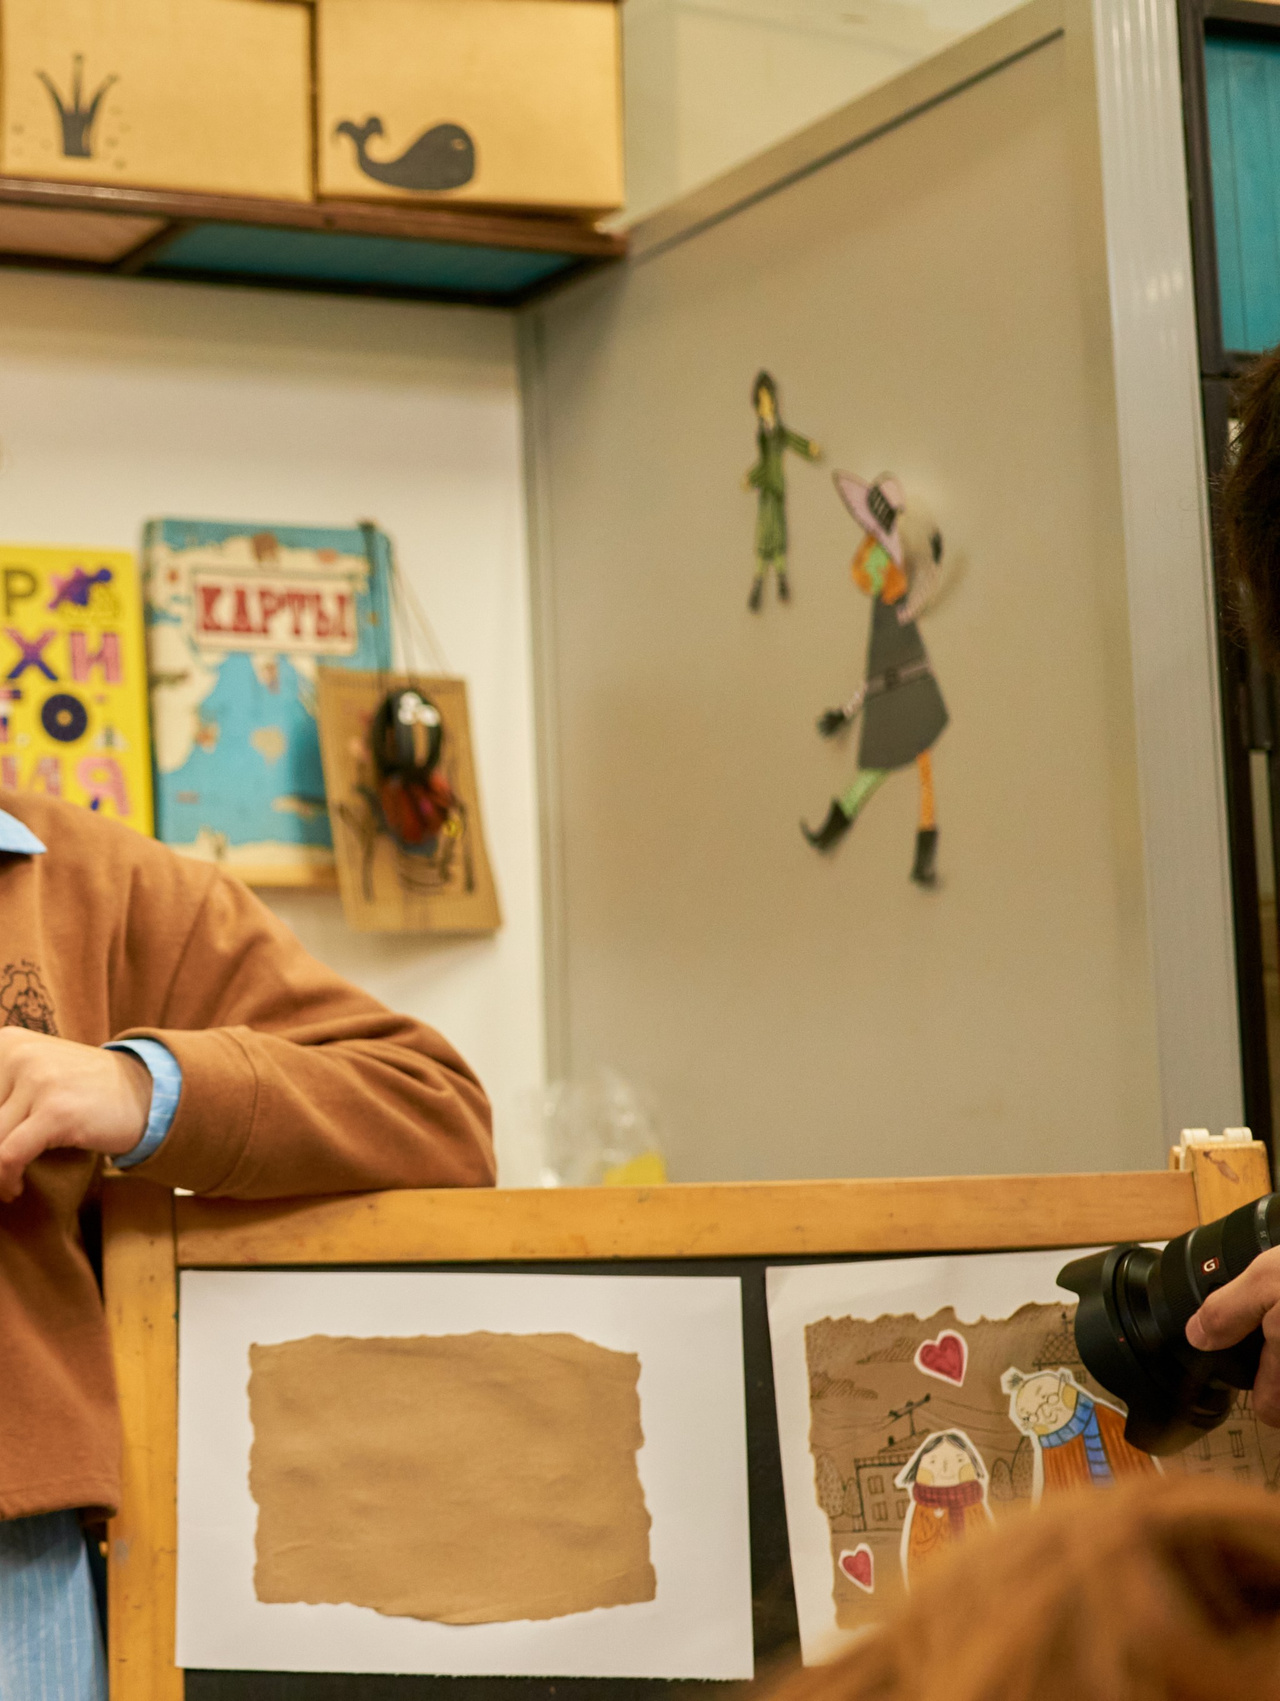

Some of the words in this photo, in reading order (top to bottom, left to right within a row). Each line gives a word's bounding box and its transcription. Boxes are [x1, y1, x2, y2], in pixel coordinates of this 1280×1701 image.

[200, 585, 348, 637] КАРТЫ
[6, 626, 122, 683] ХИ
[1203, 1258, 1216, 1272] G
